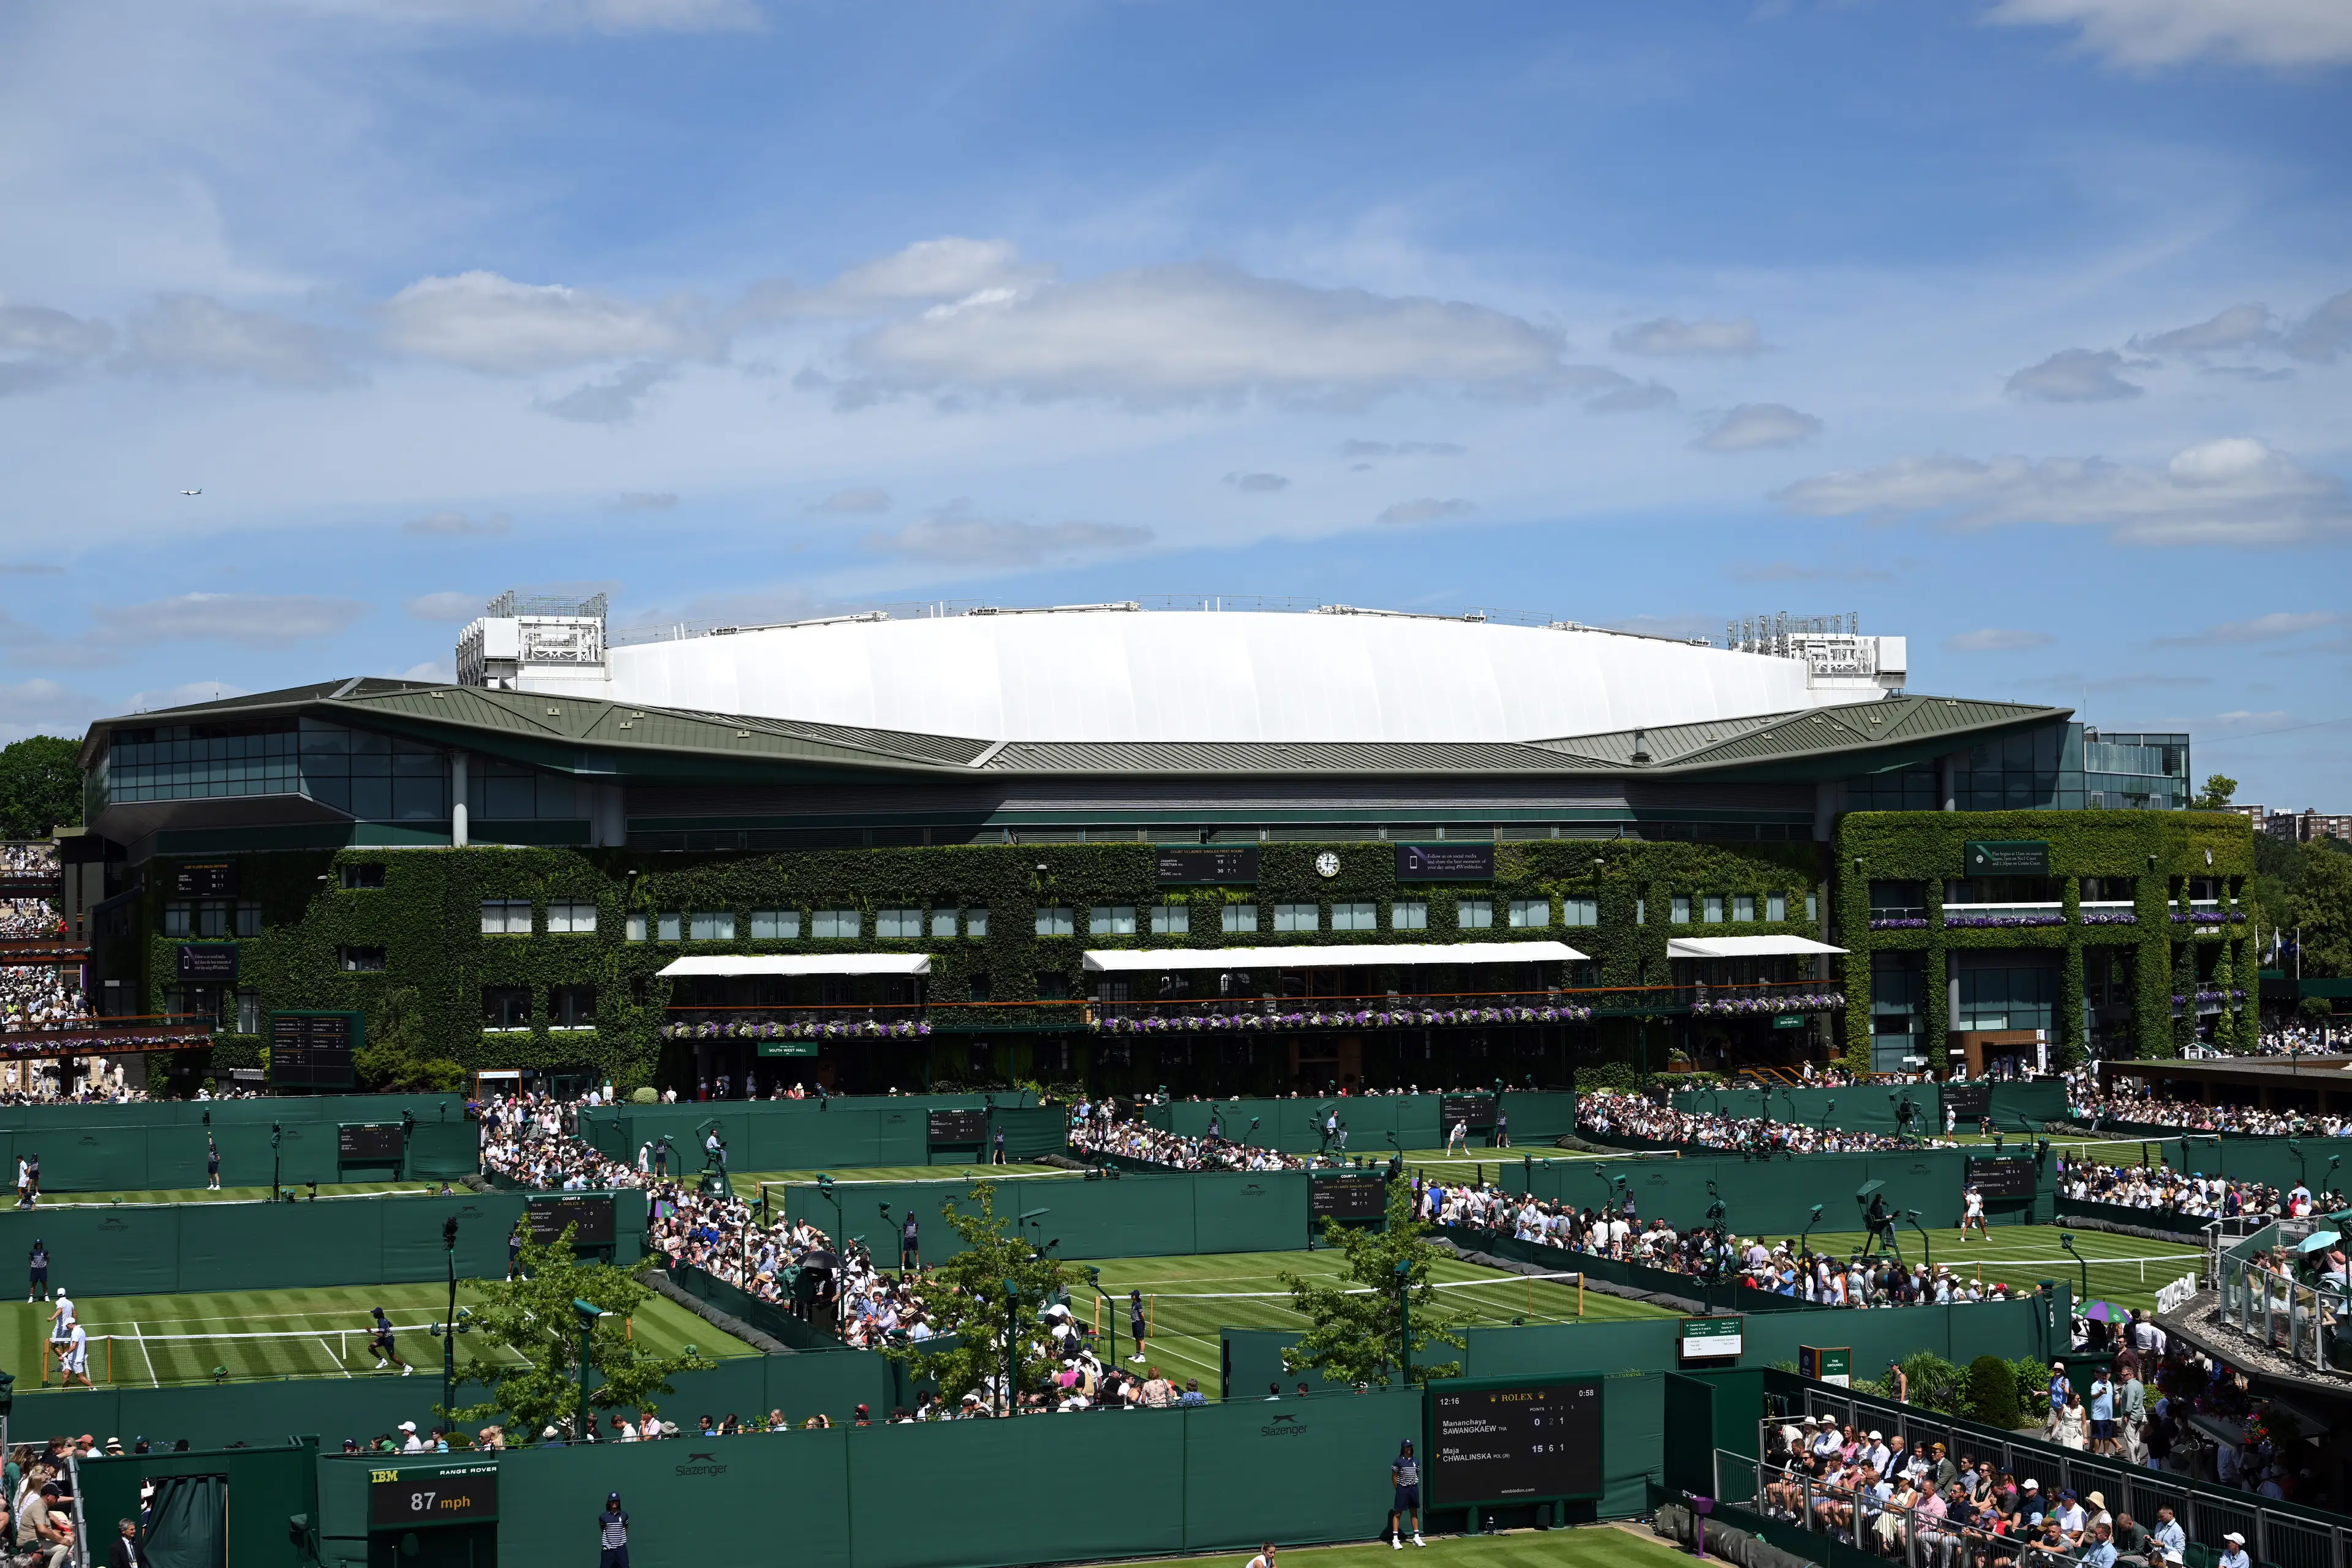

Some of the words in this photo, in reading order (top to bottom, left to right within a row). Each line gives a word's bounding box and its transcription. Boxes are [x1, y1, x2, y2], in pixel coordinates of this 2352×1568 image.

[2050, 1311, 2054, 1327] 9
[1502, 1393, 1533, 1402] ROLEX
[1443, 1419, 1486, 1428] Mananchaya
[1261, 1425, 1308, 1437] Slazenger
[1442, 1425, 1496, 1435] SAWANGKAEW
[1443, 1453, 1491, 1462] CHWALINSKA
[372, 1470, 398, 1483] IBM
[676, 1465, 728, 1477] Slazenger
[411, 1492, 436, 1511] 87
[440, 1496, 470, 1510] mph
